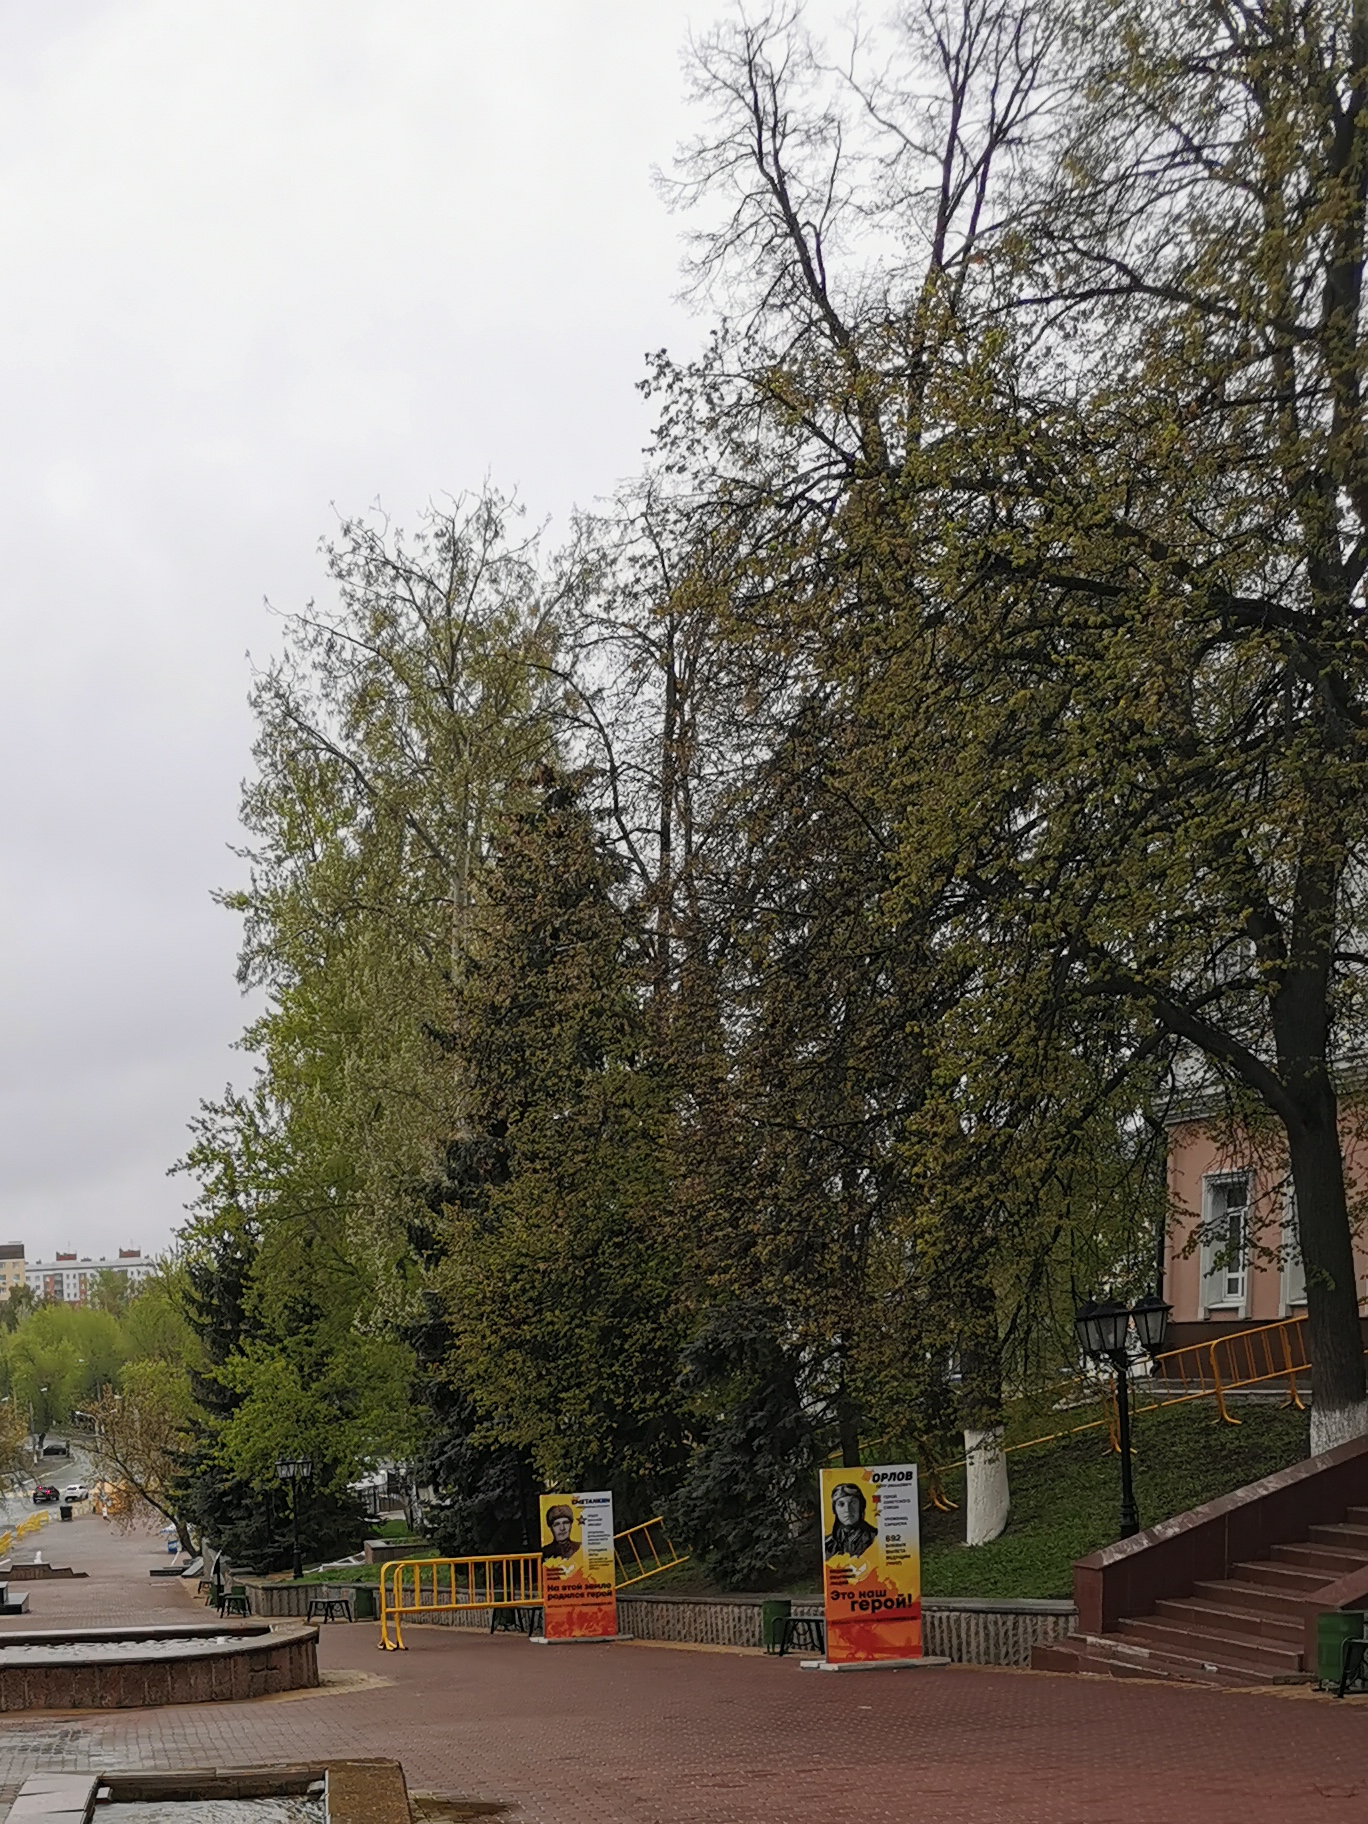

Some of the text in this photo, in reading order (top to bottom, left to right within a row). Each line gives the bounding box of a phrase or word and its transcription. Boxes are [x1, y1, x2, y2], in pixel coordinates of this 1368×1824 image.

[872, 1471, 913, 1483] ОРЛОВ
[885, 1534, 901, 1542] 692
[831, 1590, 886, 1600] Это наш
[851, 1593, 912, 1613] герой!
